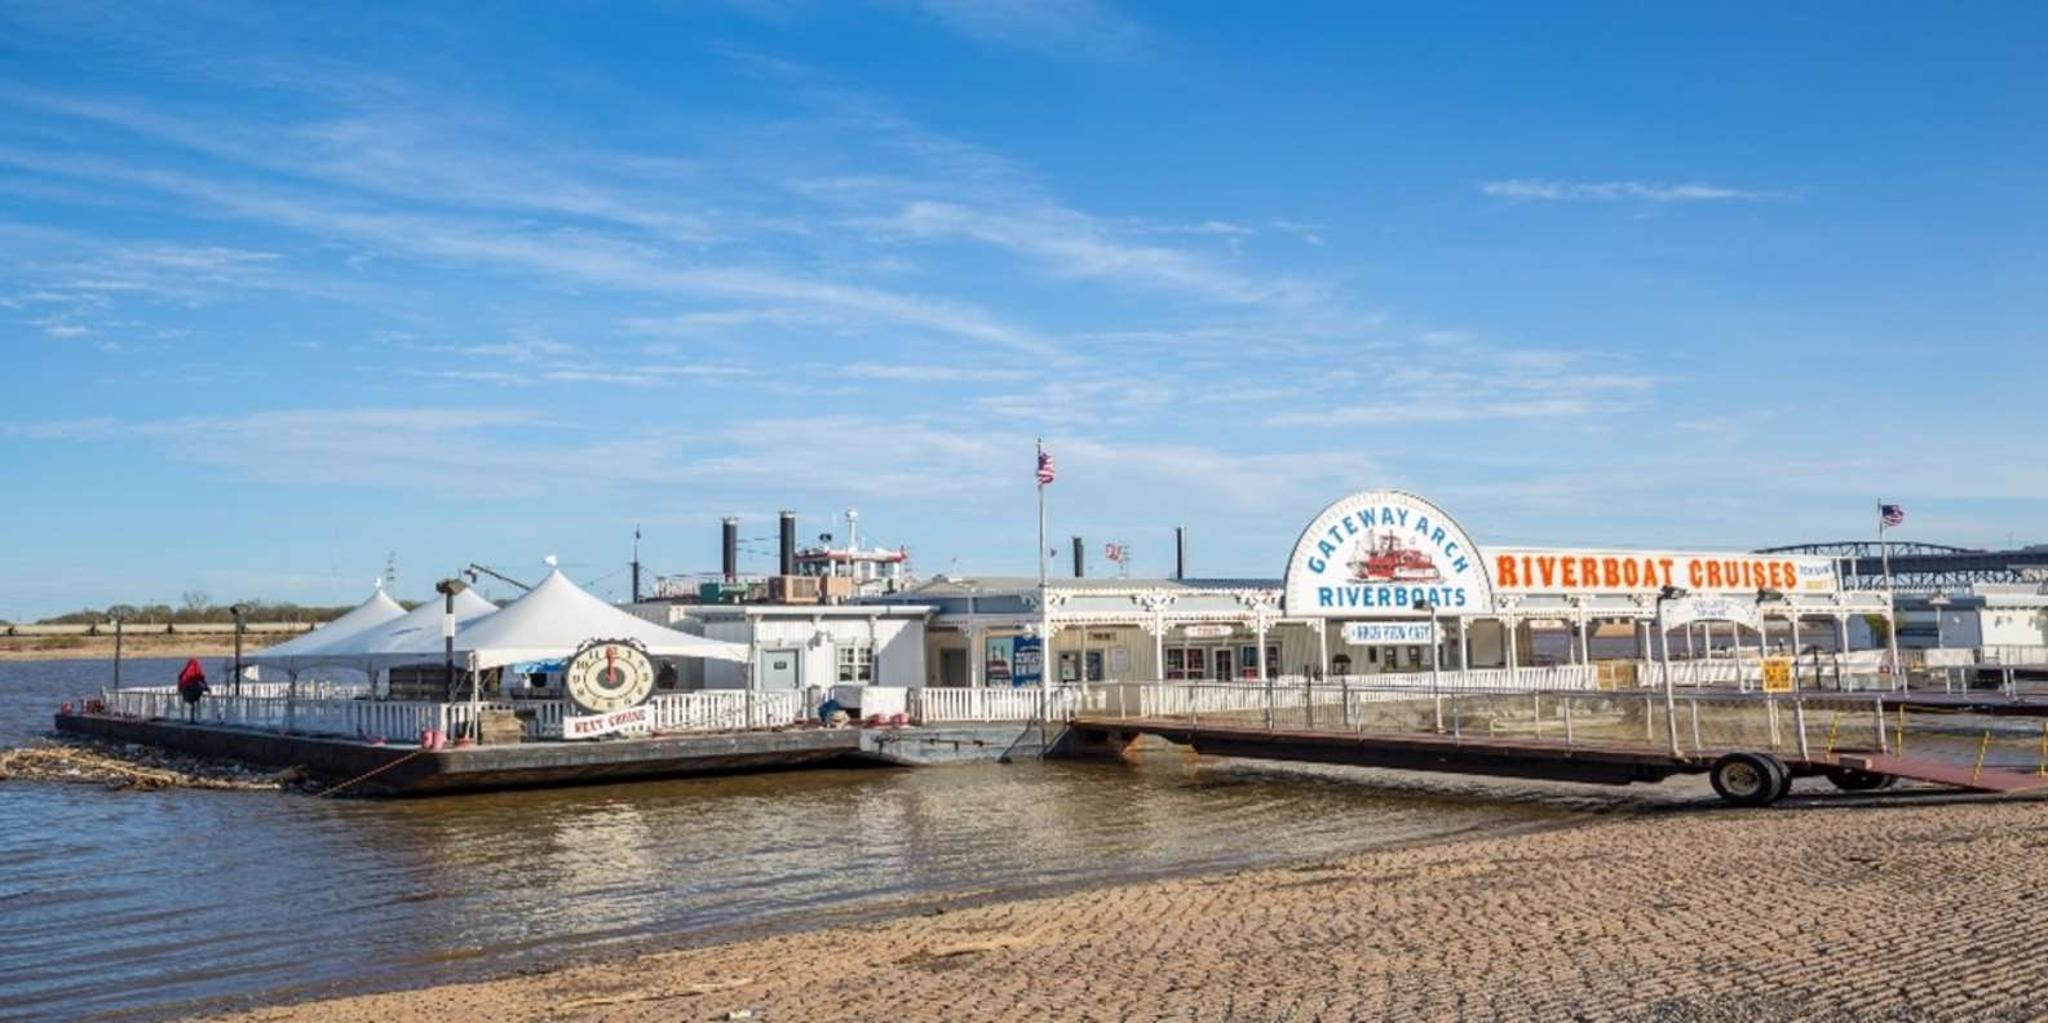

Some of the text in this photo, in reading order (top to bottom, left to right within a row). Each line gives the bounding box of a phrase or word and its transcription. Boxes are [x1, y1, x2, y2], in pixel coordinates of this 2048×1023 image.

[1308, 507, 1469, 574] GATEWAY ARCH
[1496, 555, 1797, 589] RIVERBOAT CRUISES
[1317, 586, 1466, 607] RIVERBOATS
